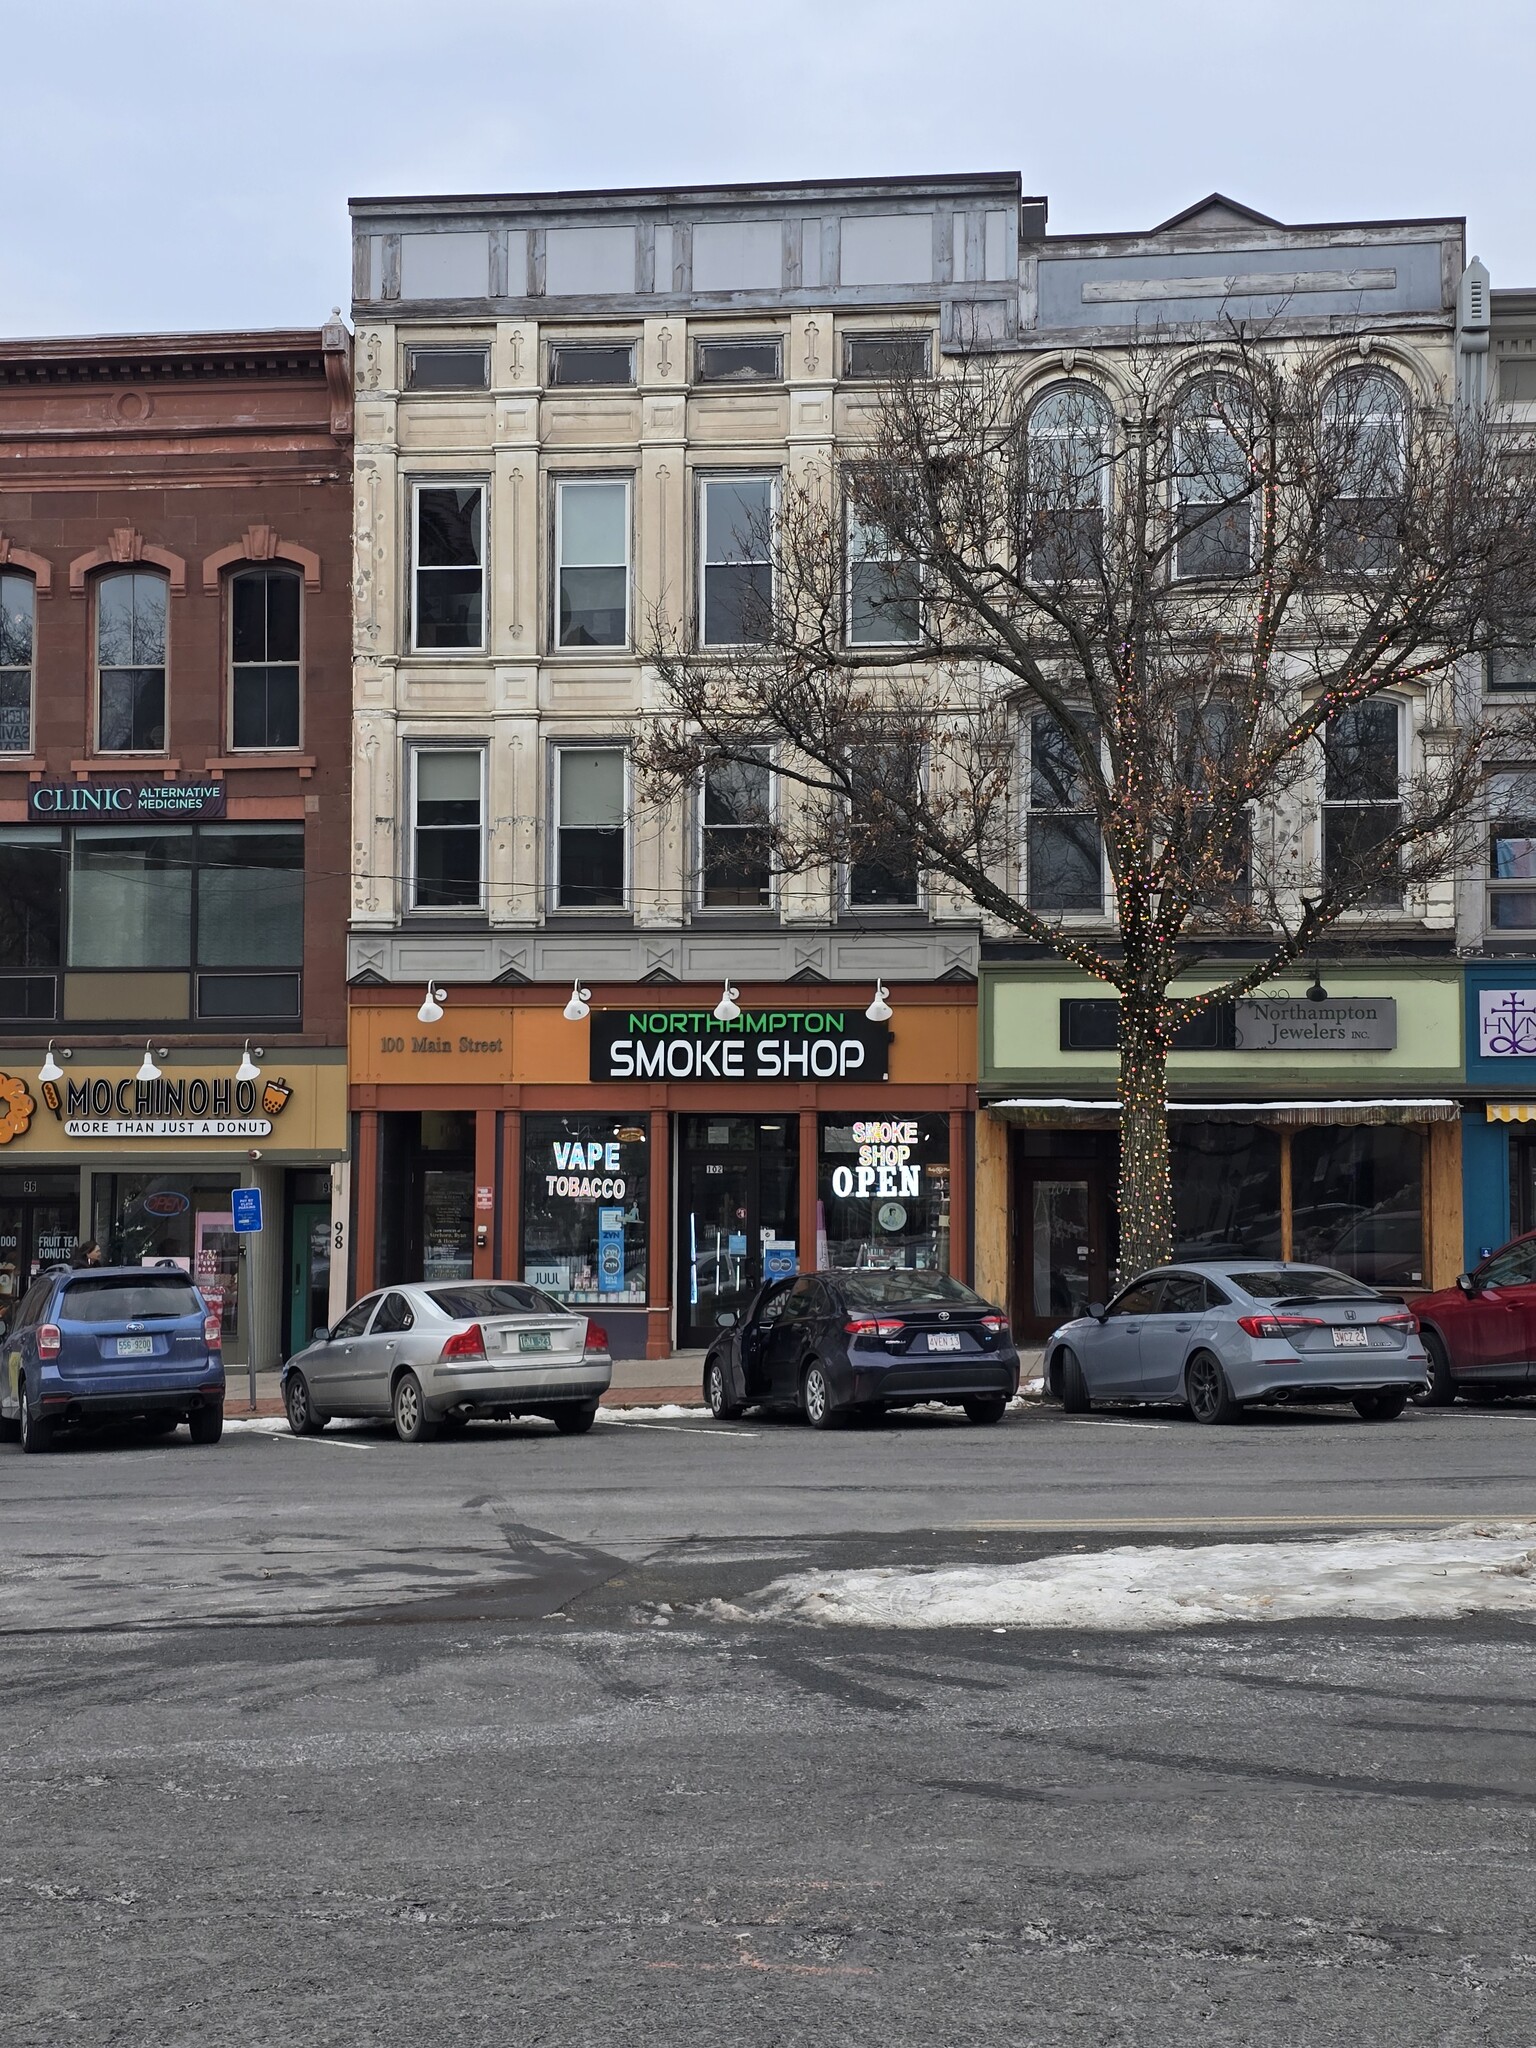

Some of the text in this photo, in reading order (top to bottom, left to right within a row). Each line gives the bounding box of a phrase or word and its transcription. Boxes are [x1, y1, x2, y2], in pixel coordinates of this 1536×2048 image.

[33, 788, 133, 811] CLINIC
[139, 787, 220, 798] ALTERNATIVE
[138, 799, 203, 810] MEDICINES
[629, 1013, 844, 1033] NORTHAMPTON
[1254, 1003, 1377, 1024] Northampton
[1268, 1023, 1370, 1045] Jewelers INC.
[381, 1036, 503, 1053] 100 Main Street
[610, 1040, 865, 1077] SMOKE SHOP
[67, 1078, 256, 1115] MOCHINOHO
[69, 1122, 267, 1133] MORE THAN JUST A DONUT
[852, 1122, 918, 1143] SMOKE
[553, 1142, 620, 1170] VAPE
[859, 1145, 910, 1166] SHOP
[707, 1166, 723, 1174] 102
[25, 1182, 36, 1192] 96
[546, 1176, 625, 1199] TOBACCO
[832, 1165, 921, 1197] OPEN
[0, 1236, 17, 1247] DOG
[39, 1236, 79, 1247] FRUIT TEA
[335, 1221, 343, 1249] 98
[39, 1248, 71, 1259] DONUTS
[535, 1272, 560, 1285] JUUL
[1355, 1332, 1366, 1342] 23
